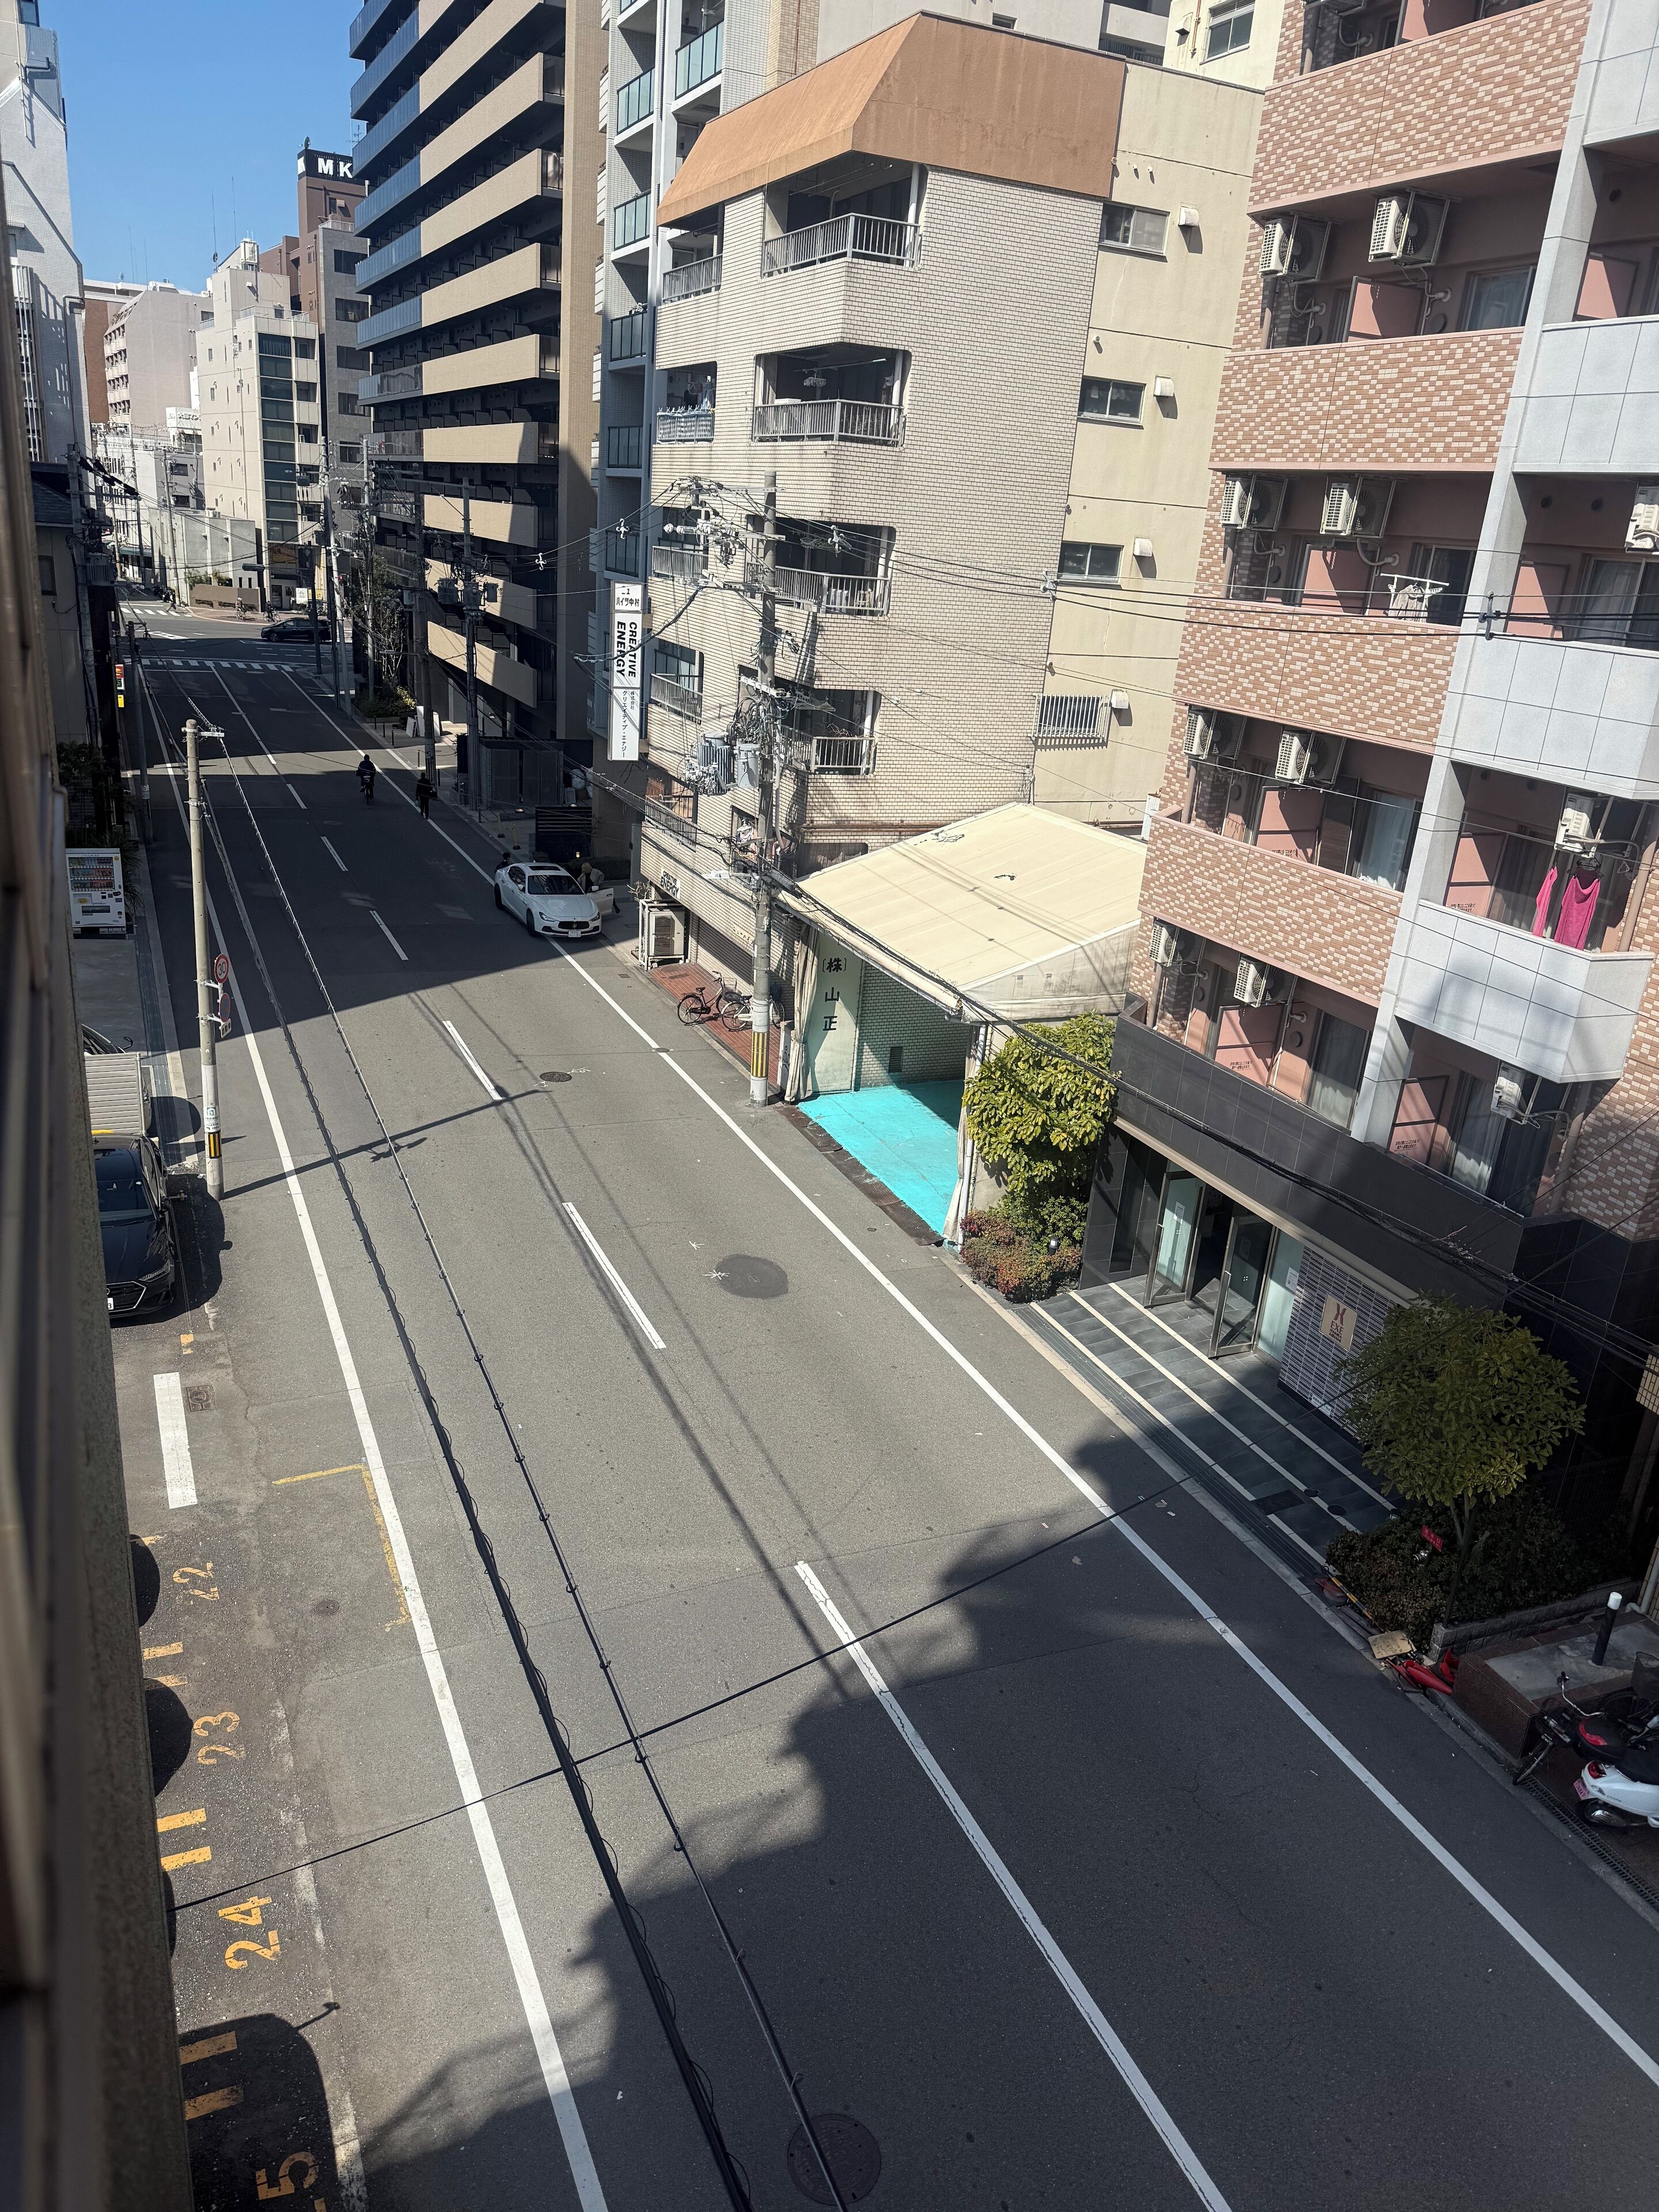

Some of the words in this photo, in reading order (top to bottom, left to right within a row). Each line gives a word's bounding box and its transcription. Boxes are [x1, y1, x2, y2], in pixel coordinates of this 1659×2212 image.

[616, 597, 639, 607] ハイツ中村
[616, 621, 626, 677] ENERGY
[628, 622, 637, 677] CREATIVE
[661, 876, 679, 898] ENERGY
[218, 961, 226, 976] 30
[1331, 1320, 1344, 1335] EXE
[193, 1711, 244, 1765] 23
[219, 1896, 281, 1969] 24
[256, 2151, 327, 2211] 5
